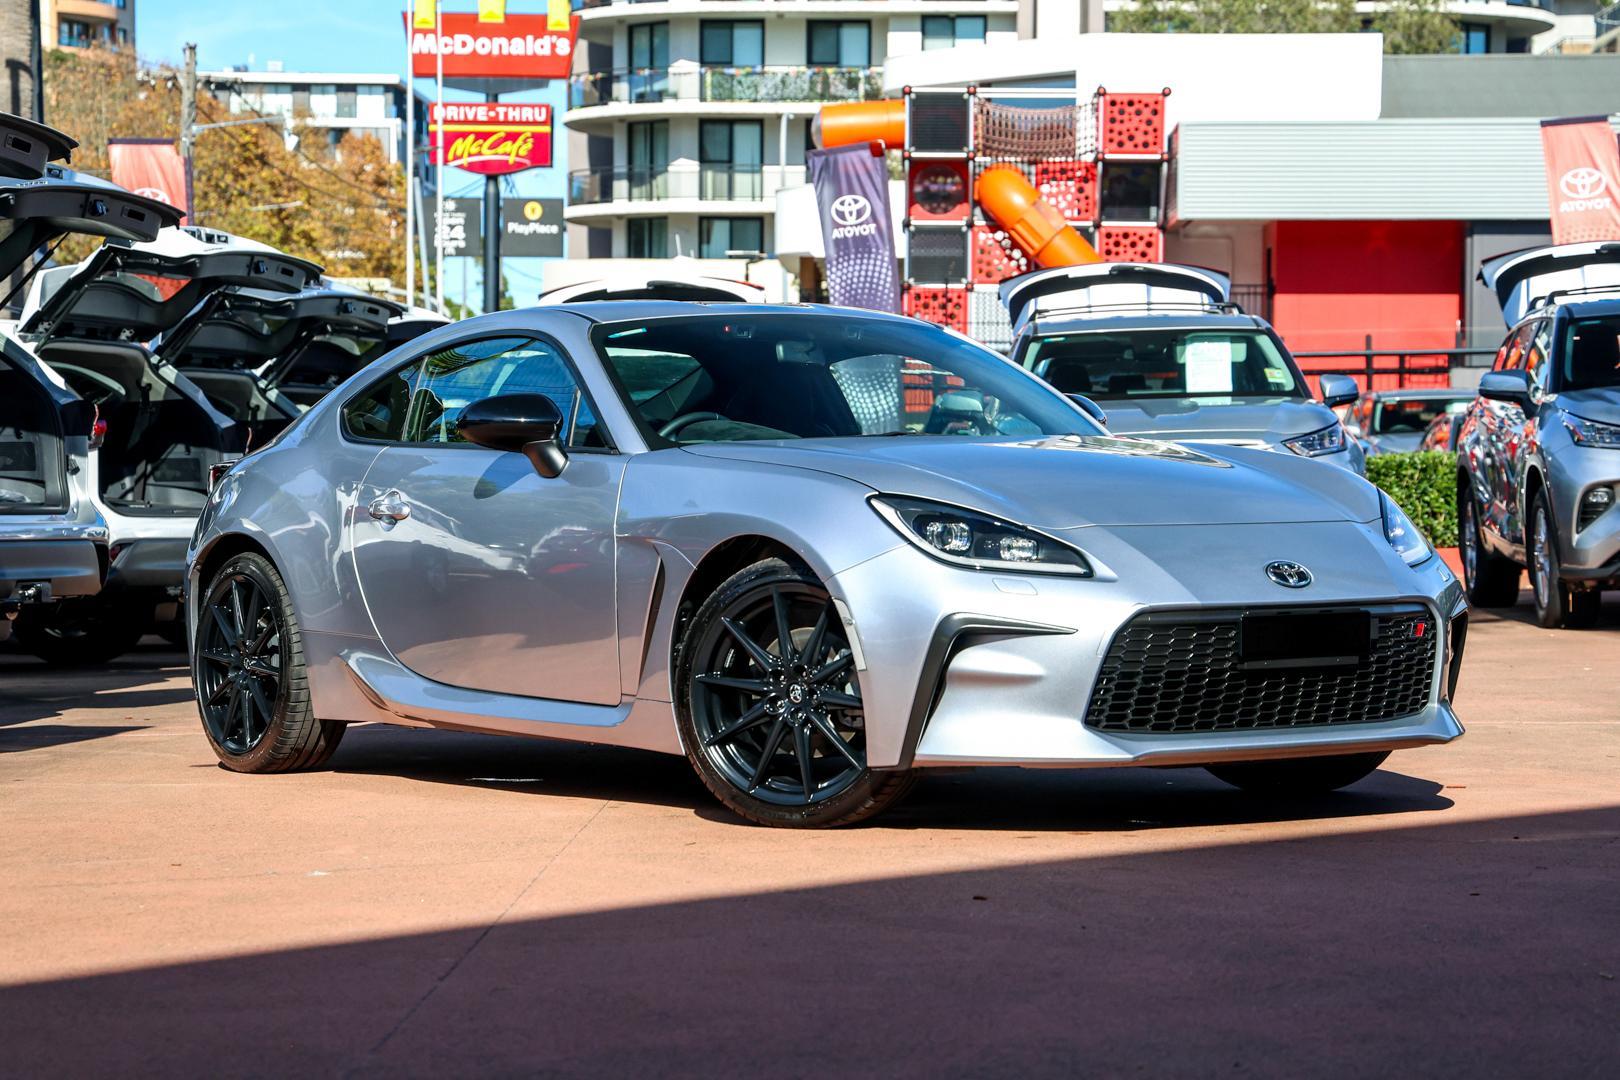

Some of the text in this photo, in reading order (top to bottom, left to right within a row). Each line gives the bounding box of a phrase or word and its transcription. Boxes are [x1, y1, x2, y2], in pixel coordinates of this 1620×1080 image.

[412, 33, 571, 56] McDonald's
[433, 105, 547, 122] DRIVE-THRU
[447, 131, 534, 167] McCafé
[507, 221, 559, 236] PlayPlace
